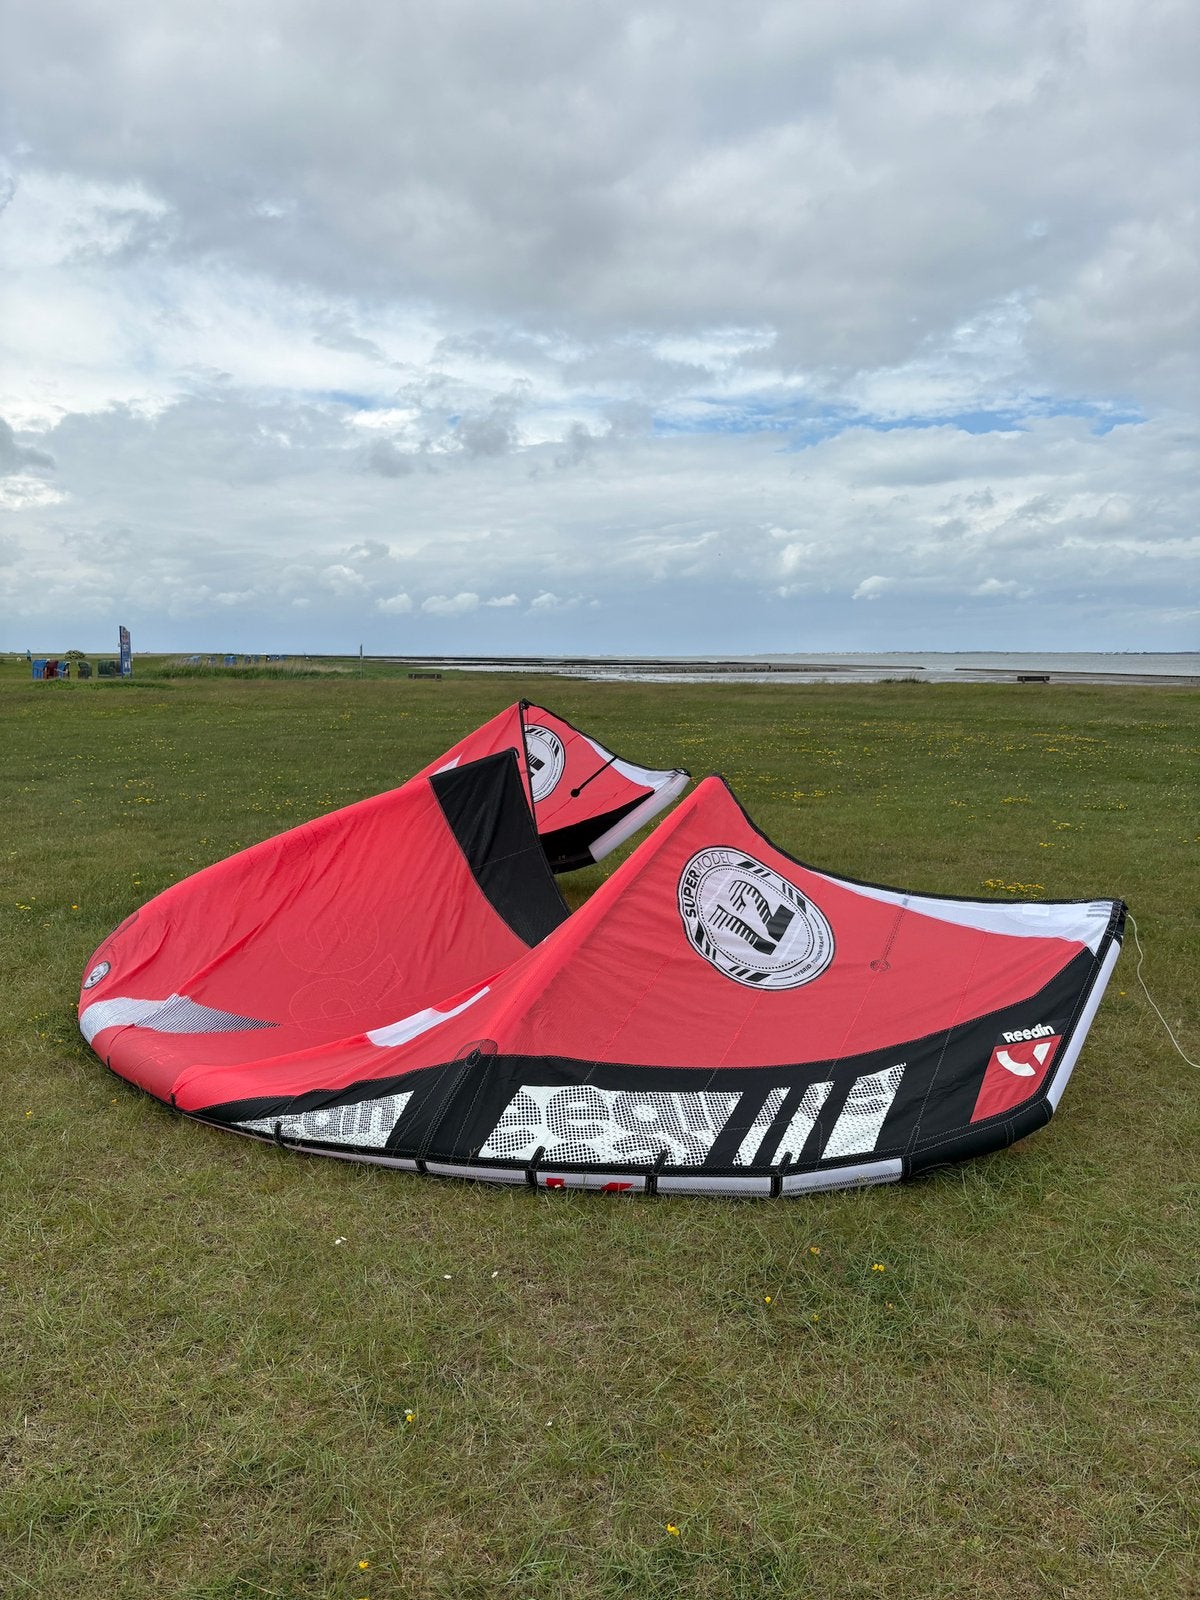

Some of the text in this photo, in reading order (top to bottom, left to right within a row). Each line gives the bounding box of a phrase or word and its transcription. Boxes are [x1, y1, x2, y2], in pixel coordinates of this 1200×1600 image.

[683, 852, 734, 918] SUPERMODEL
[793, 964, 811, 977] HYBRID
[1002, 1023, 1055, 1043] Reedin
